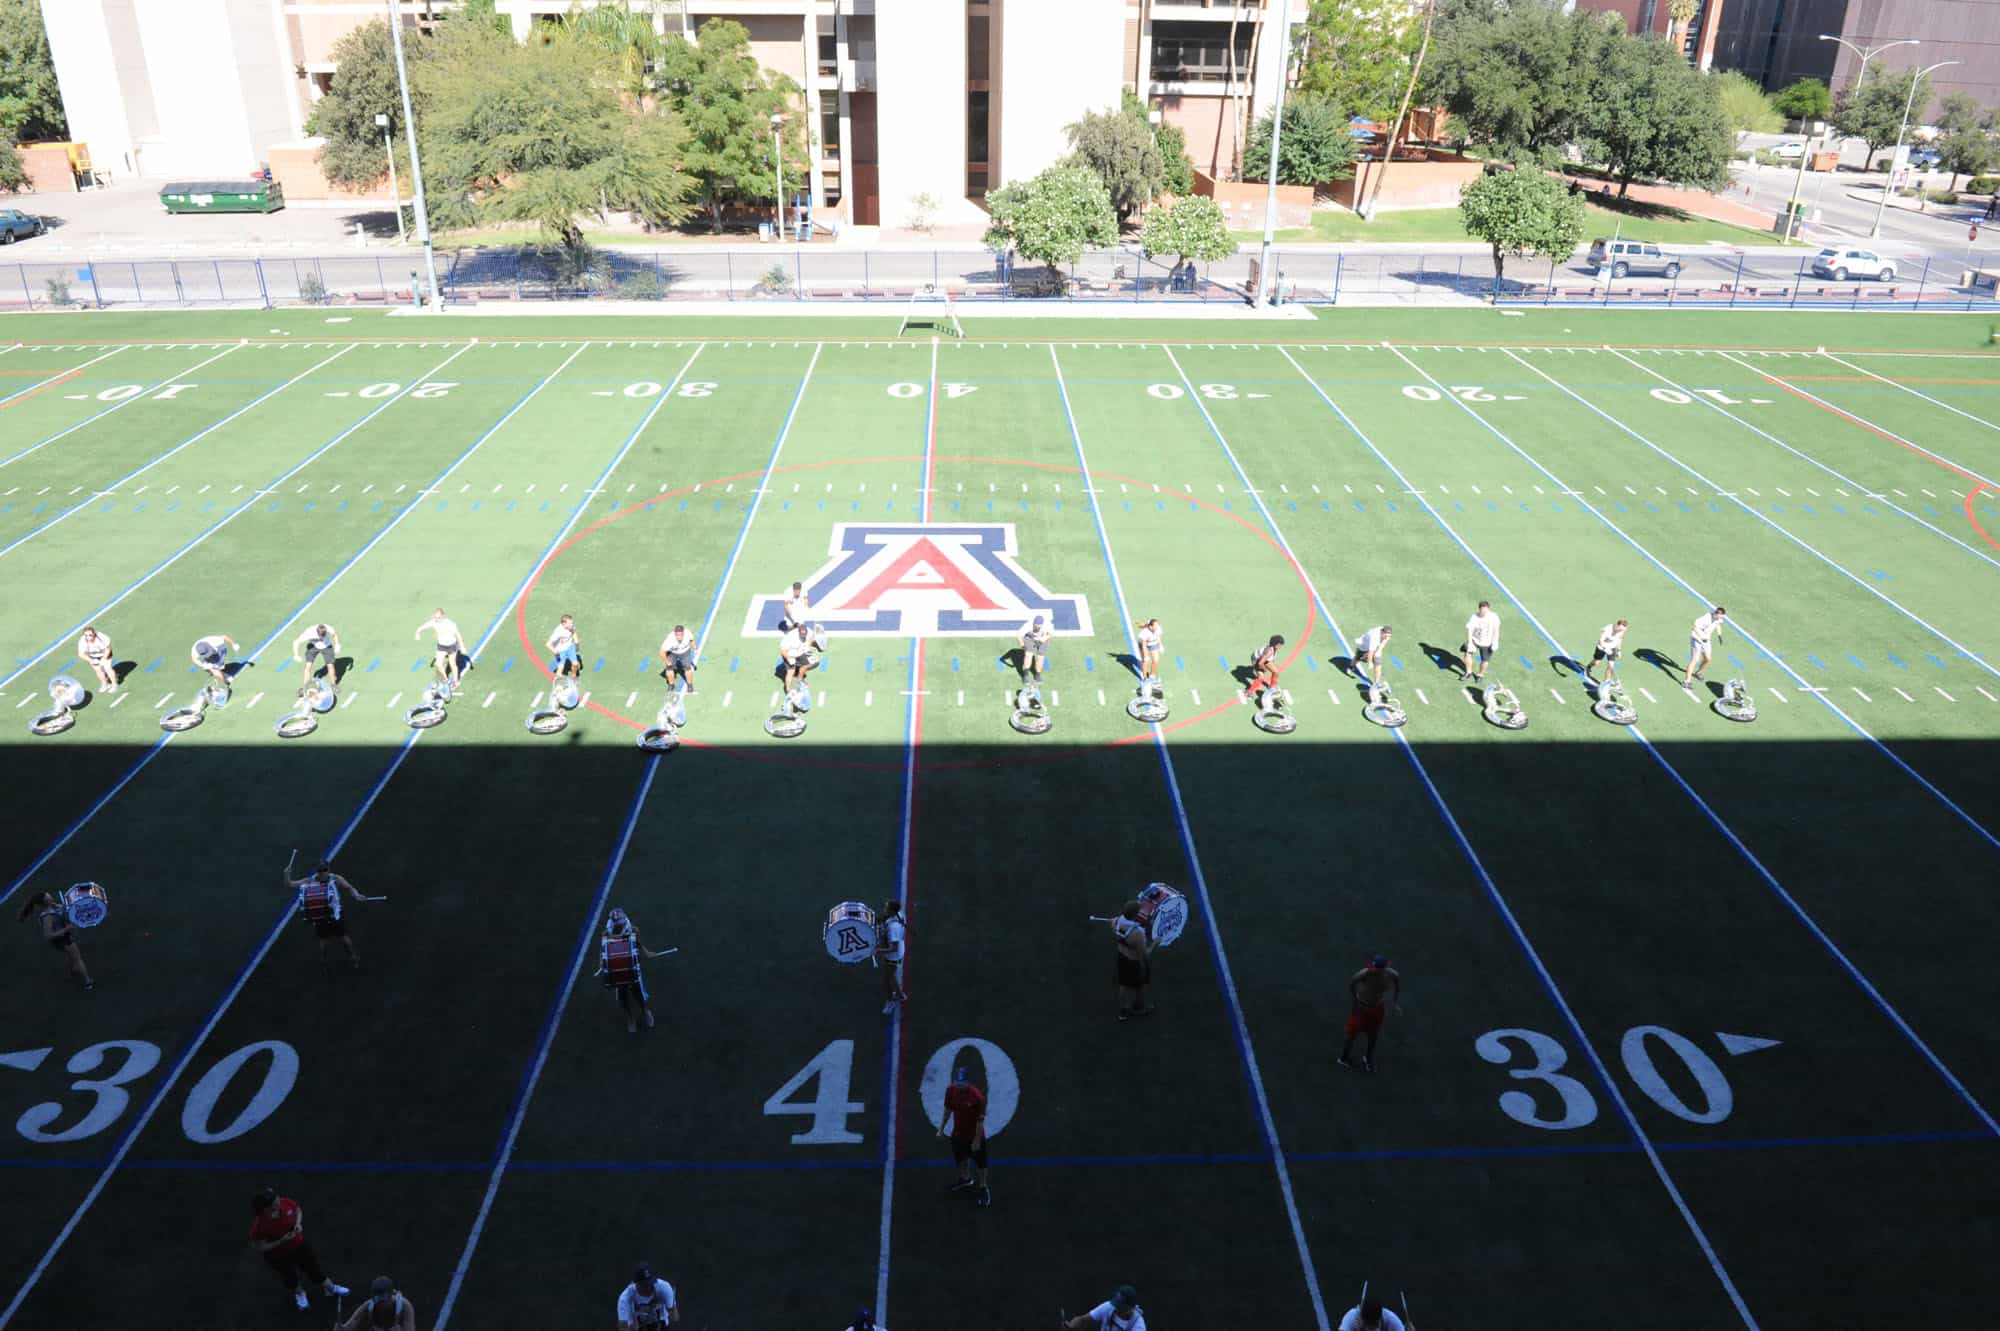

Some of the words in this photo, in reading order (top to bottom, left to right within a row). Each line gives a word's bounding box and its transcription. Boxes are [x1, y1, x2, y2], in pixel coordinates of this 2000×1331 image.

[96, 384, 198, 400] 10
[358, 382, 460, 398] 20
[623, 381, 718, 398] 30
[886, 382, 979, 398] 40
[1146, 383, 1239, 399] 30
[1401, 385, 1496, 401] 20
[1649, 388, 1743, 404] 10
[742, 523, 1094, 637] A
[837, 926, 869, 955] A
[1475, 1024, 1734, 1130] 30
[15, 1039, 300, 1144] 30
[763, 1037, 1020, 1144] 40
